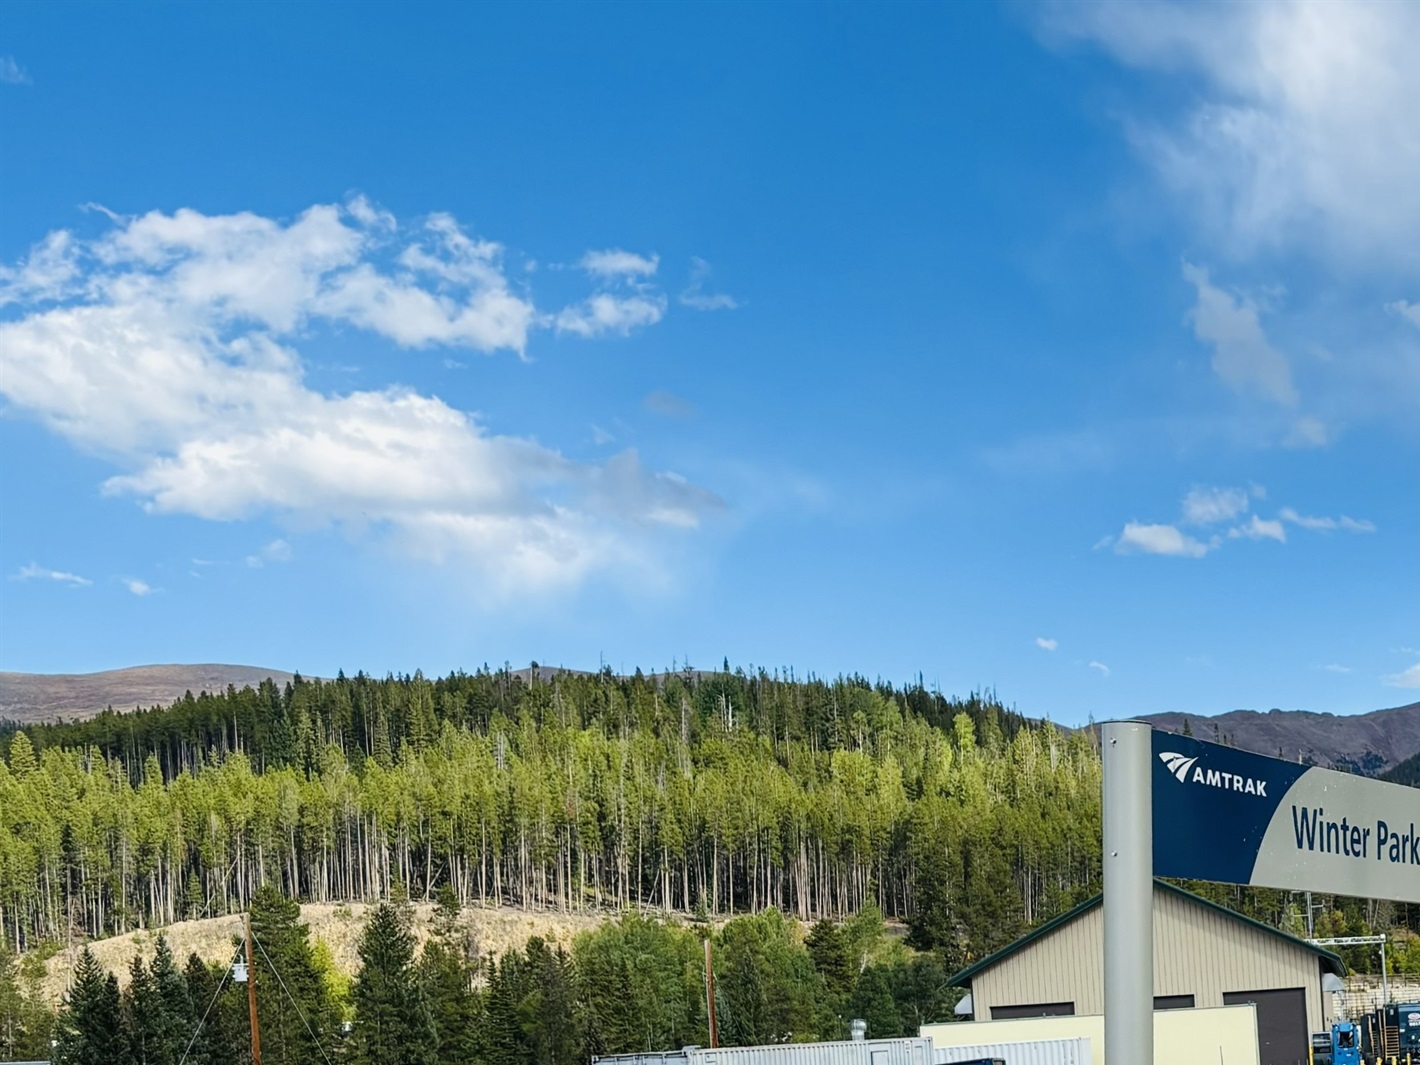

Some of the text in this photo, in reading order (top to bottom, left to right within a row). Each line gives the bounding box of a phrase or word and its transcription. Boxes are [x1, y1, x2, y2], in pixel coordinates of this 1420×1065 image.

[1192, 766, 1268, 798] AMTRAK
[1292, 805, 1370, 859] Winter
[1376, 820, 1420, 866] Park
